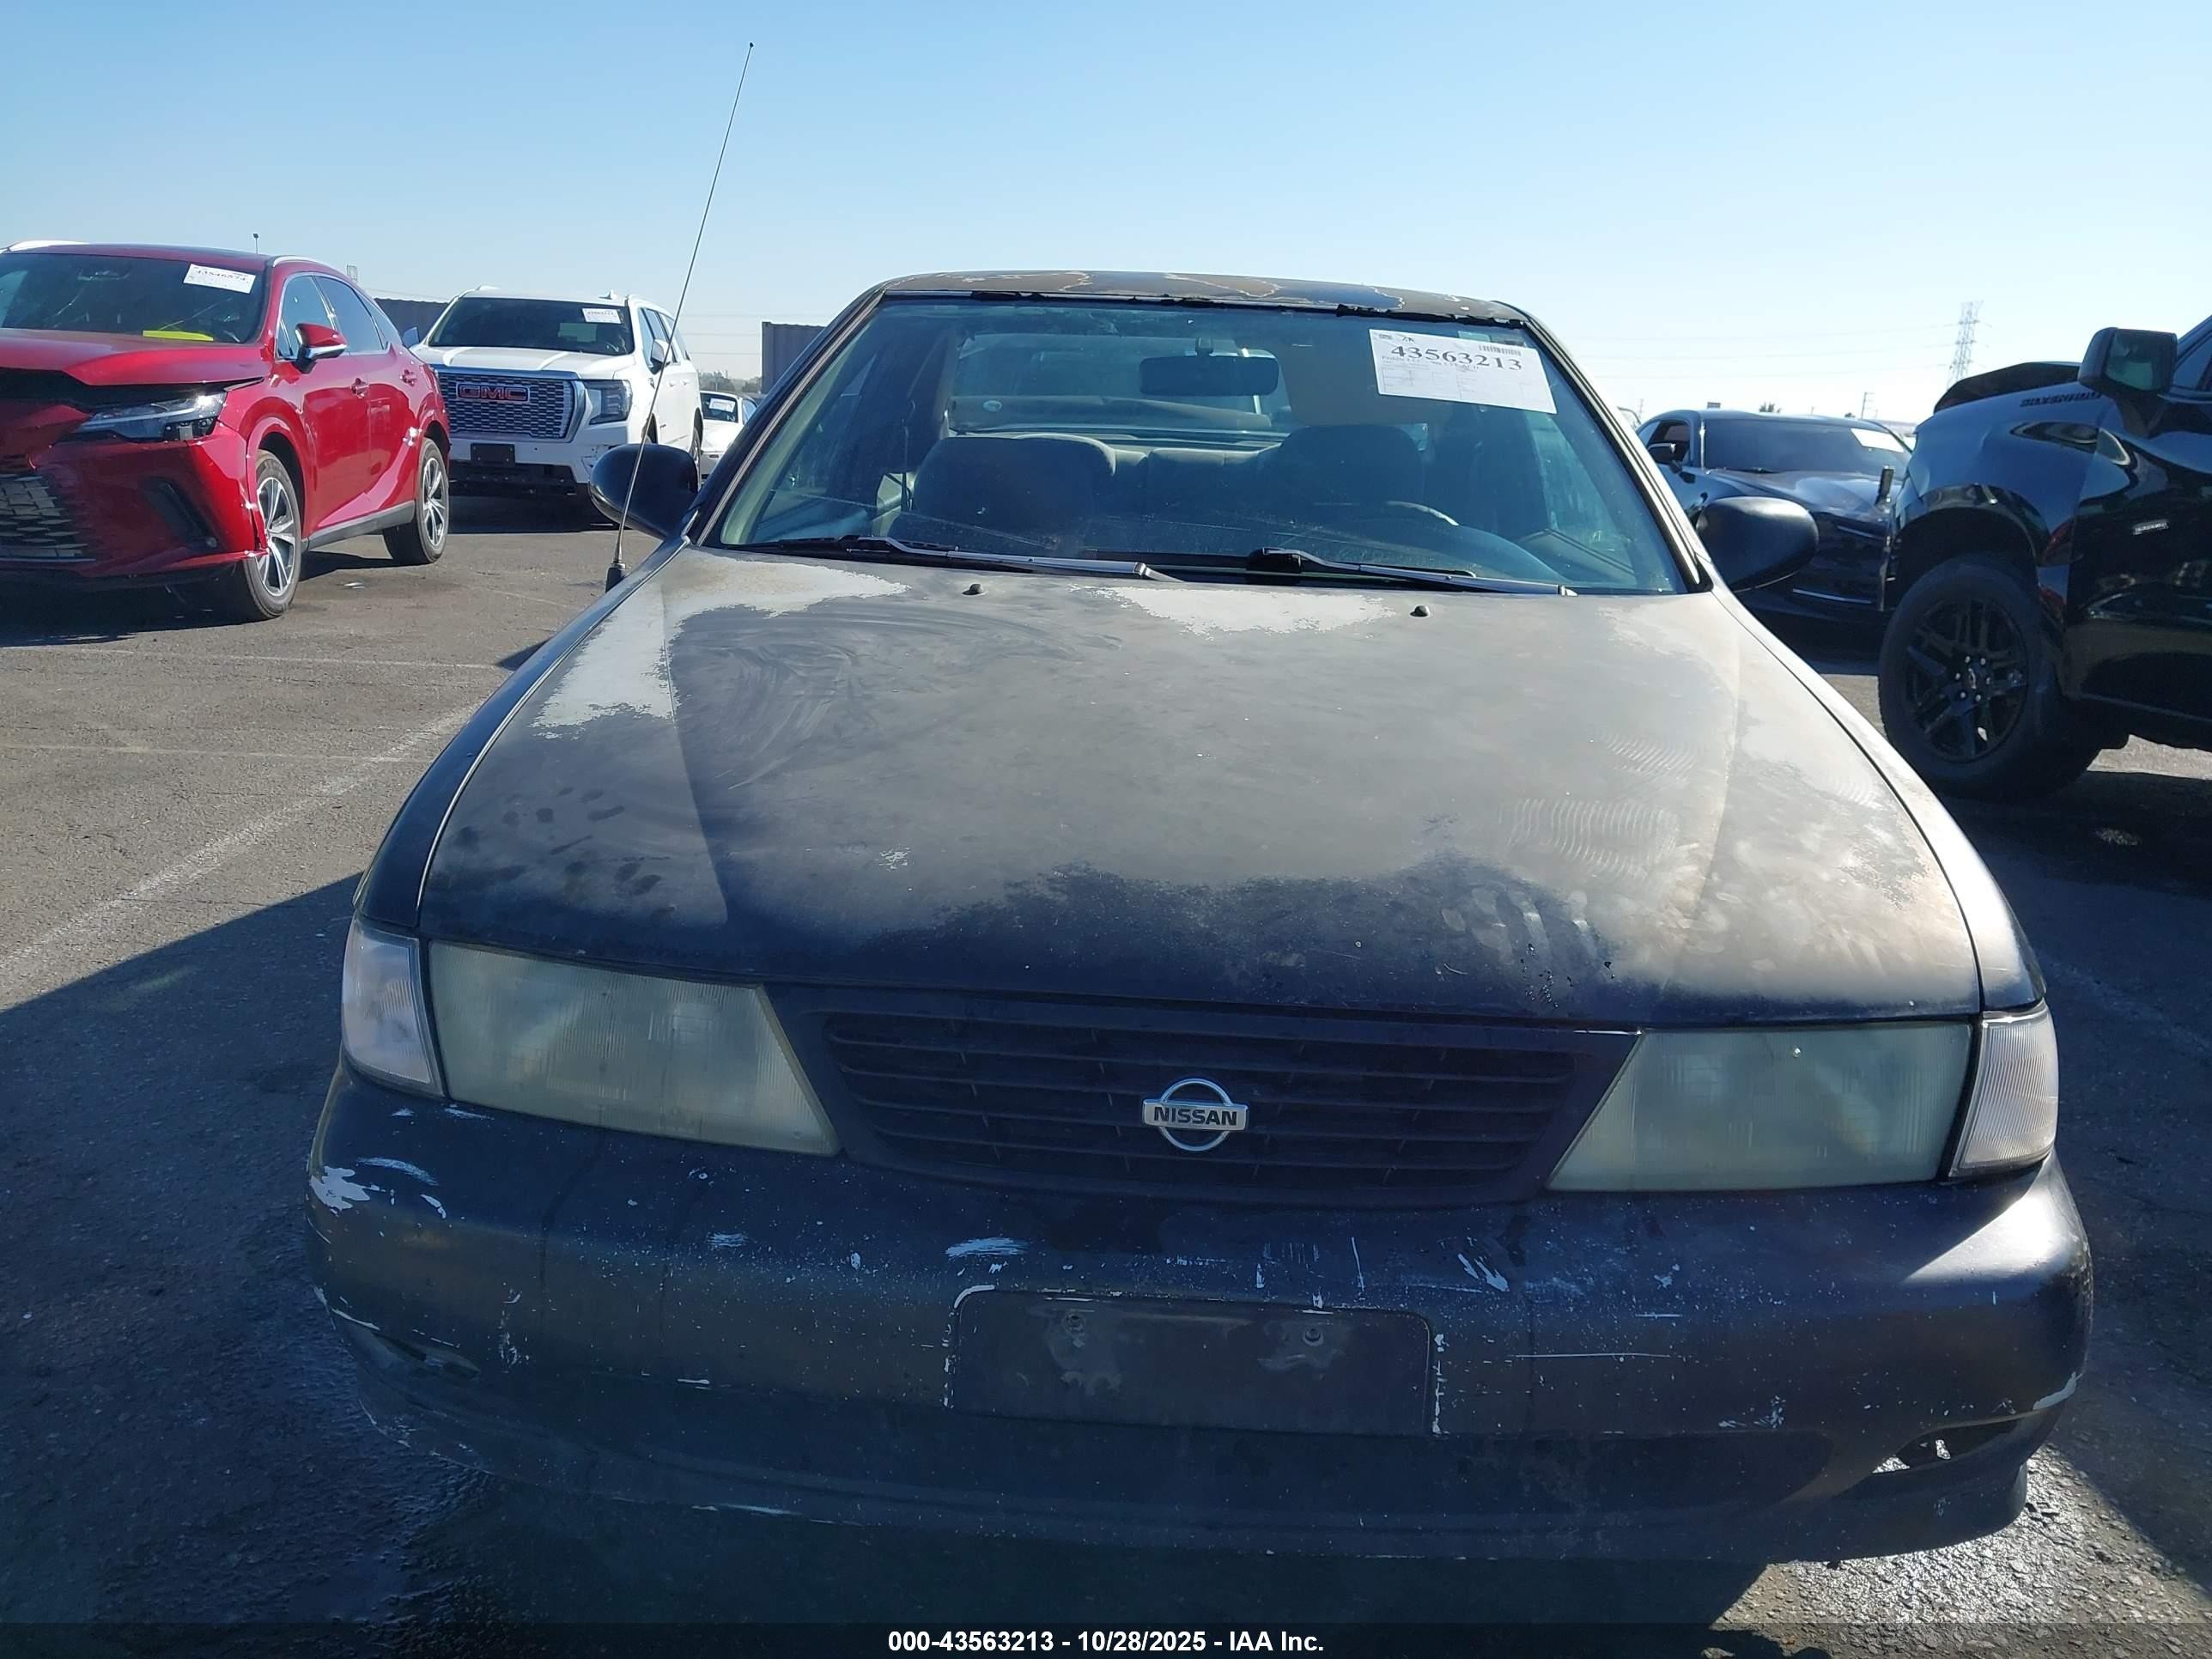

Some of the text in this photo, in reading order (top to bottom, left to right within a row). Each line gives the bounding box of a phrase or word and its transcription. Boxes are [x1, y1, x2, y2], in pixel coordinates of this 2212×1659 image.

[1391, 345, 1522, 371] 43563213
[459, 386, 526, 401] GMC
[1154, 1106, 1237, 1126] NISSAN
